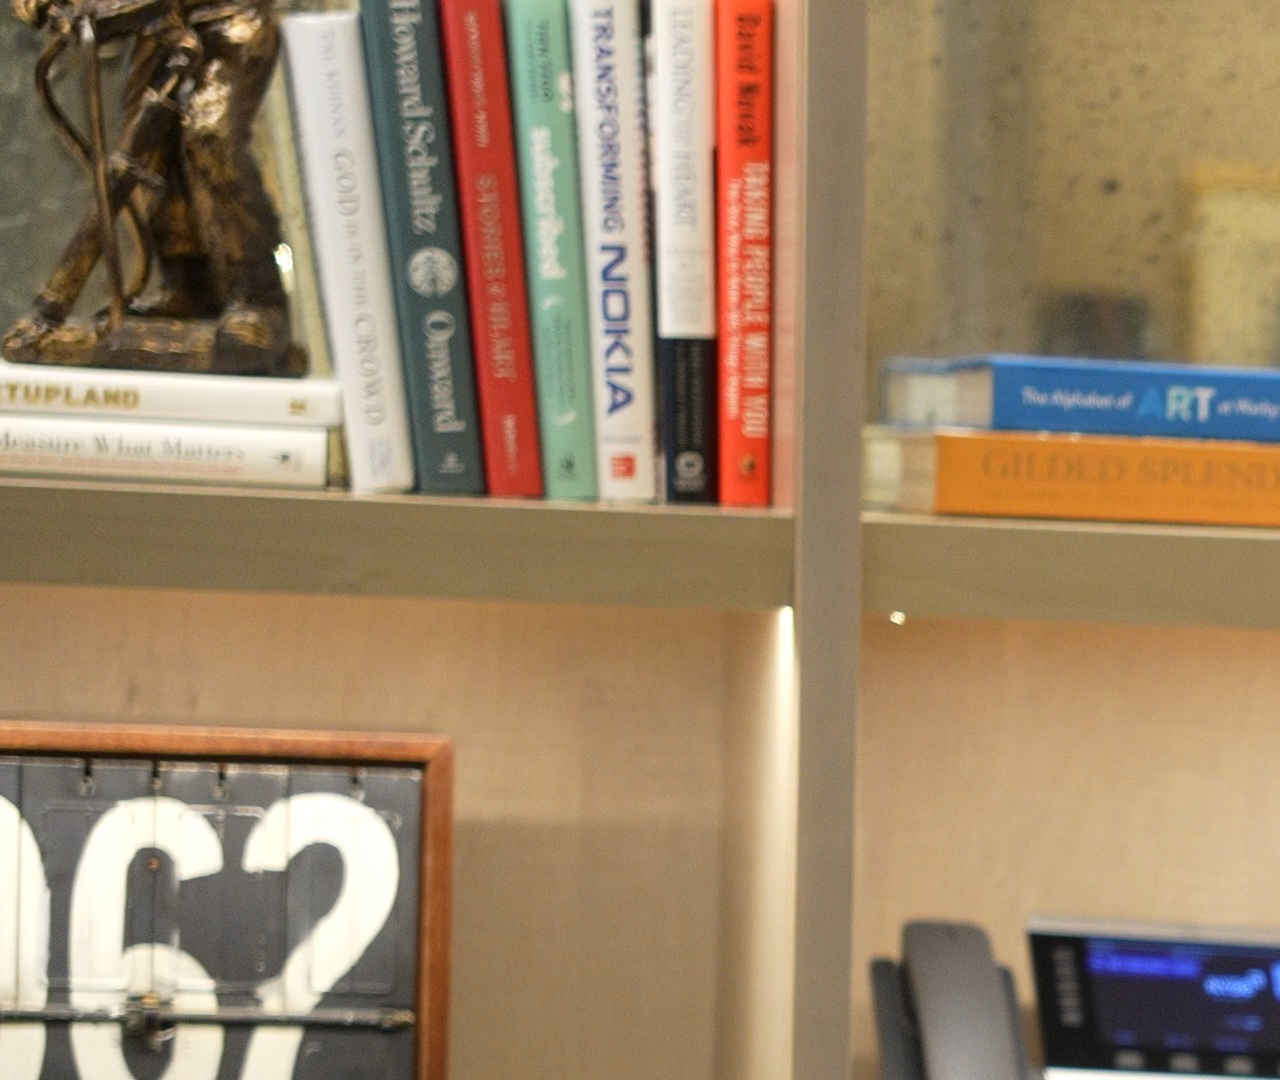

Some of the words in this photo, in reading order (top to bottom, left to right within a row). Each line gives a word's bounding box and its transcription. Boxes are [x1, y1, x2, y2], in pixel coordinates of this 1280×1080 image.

[387, 0, 433, 119] Howard
[402, 119, 443, 235] Schultz
[593, 7, 625, 234] TRANSFORMING
[531, 126, 568, 280] subscribed
[333, 149, 361, 218] GOD
[354, 313, 387, 427] CROWD
[600, 245, 634, 416] NOKIA
[742, 243, 769, 325] PEOPLE
[0, 382, 140, 409] TUPLAND
[423, 309, 467, 432] Onward
[742, 393, 768, 439] YOU
[1137, 385, 1217, 423] ART
[94, 433, 152, 457] What
[161, 435, 248, 461] Matters
[980, 453, 1126, 482] GILDED
